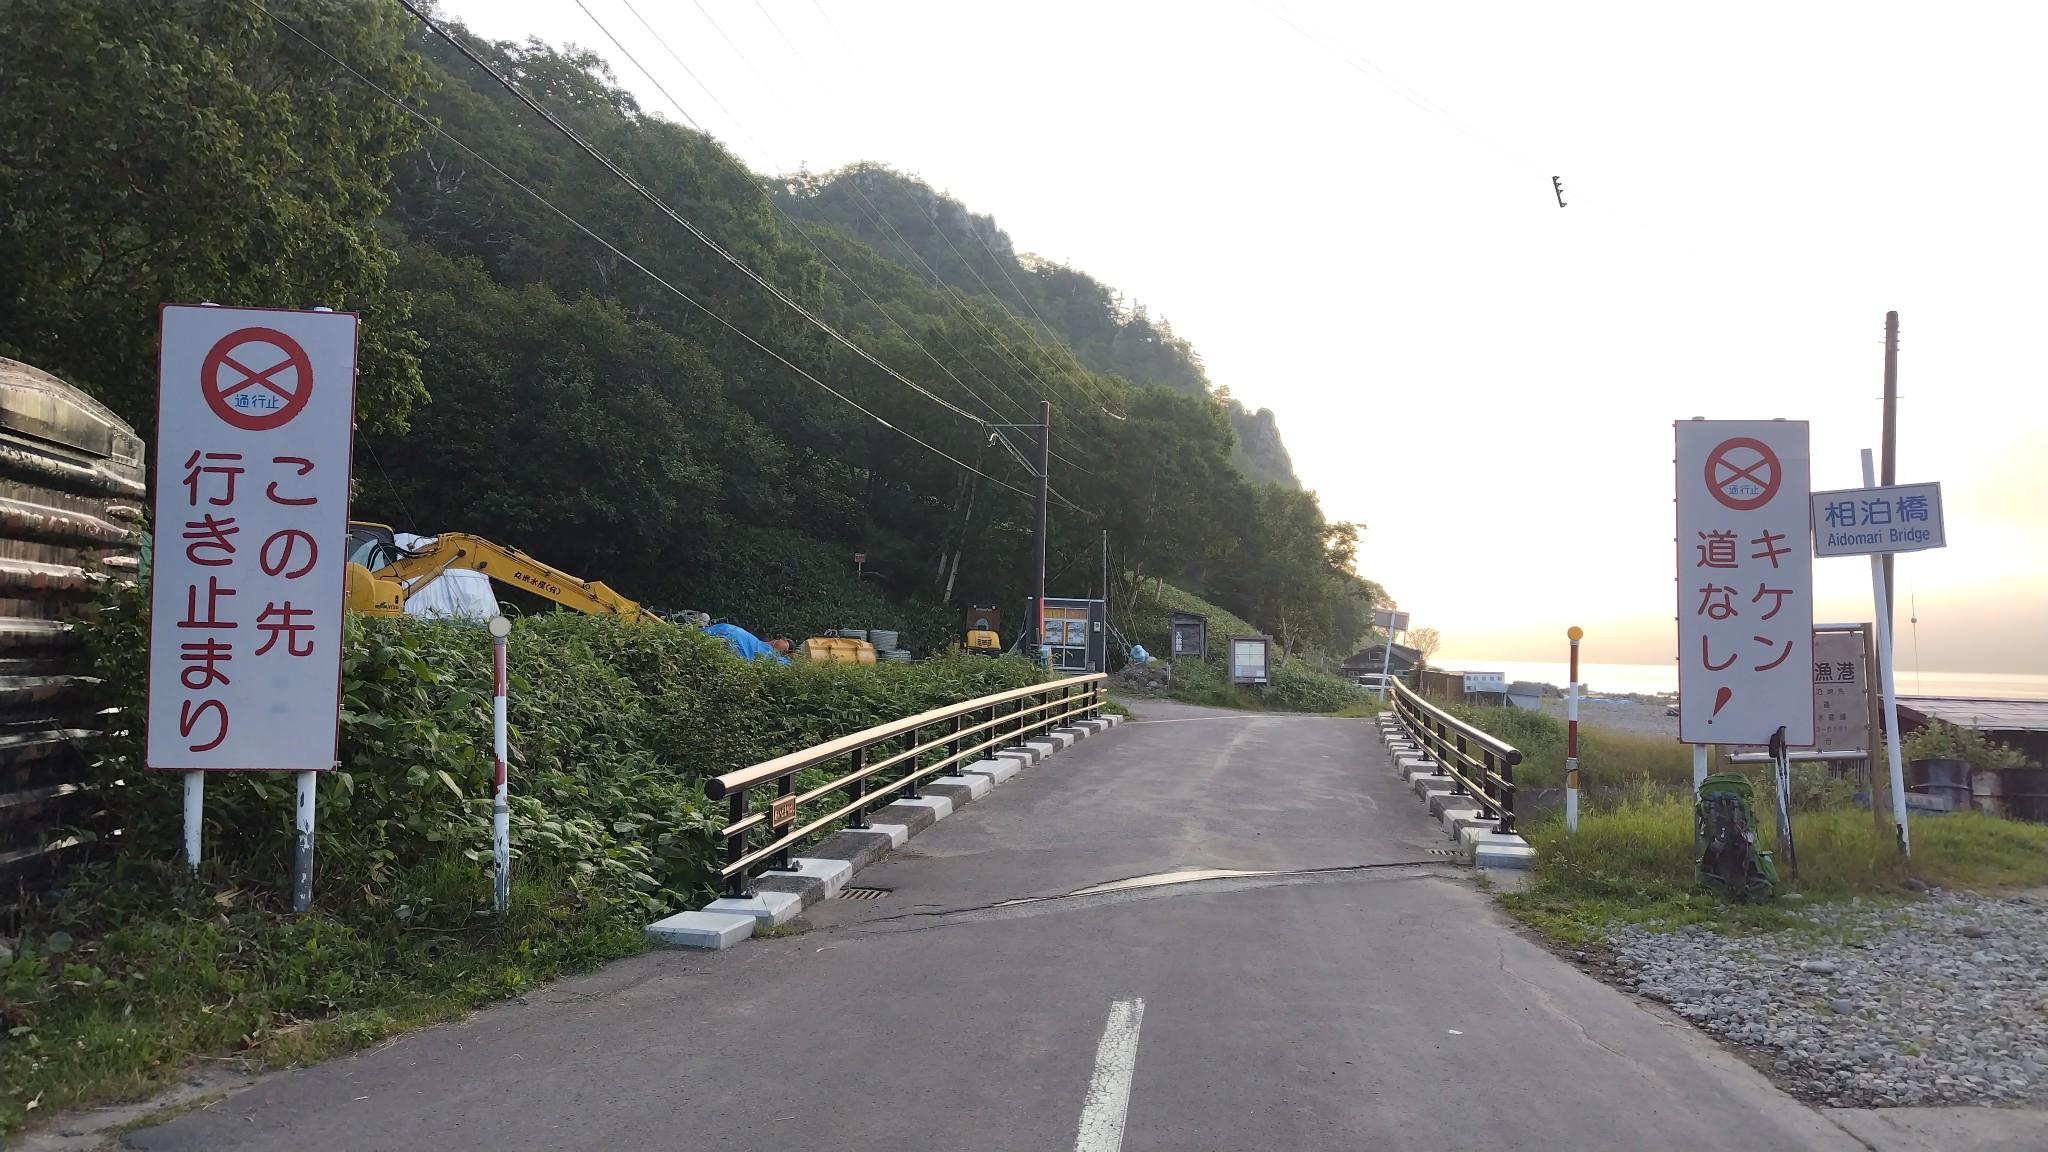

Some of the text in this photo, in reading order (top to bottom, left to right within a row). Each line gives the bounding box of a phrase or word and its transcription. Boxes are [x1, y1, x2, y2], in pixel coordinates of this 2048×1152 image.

[234, 394, 279, 409] 通行止
[1824, 495, 1929, 528] 相泊橋
[1828, 527, 1931, 547] Aidomari Bridge
[254, 456, 318, 657] この先
[1751, 529, 1794, 672] キケン
[177, 450, 245, 752] 行き止まり
